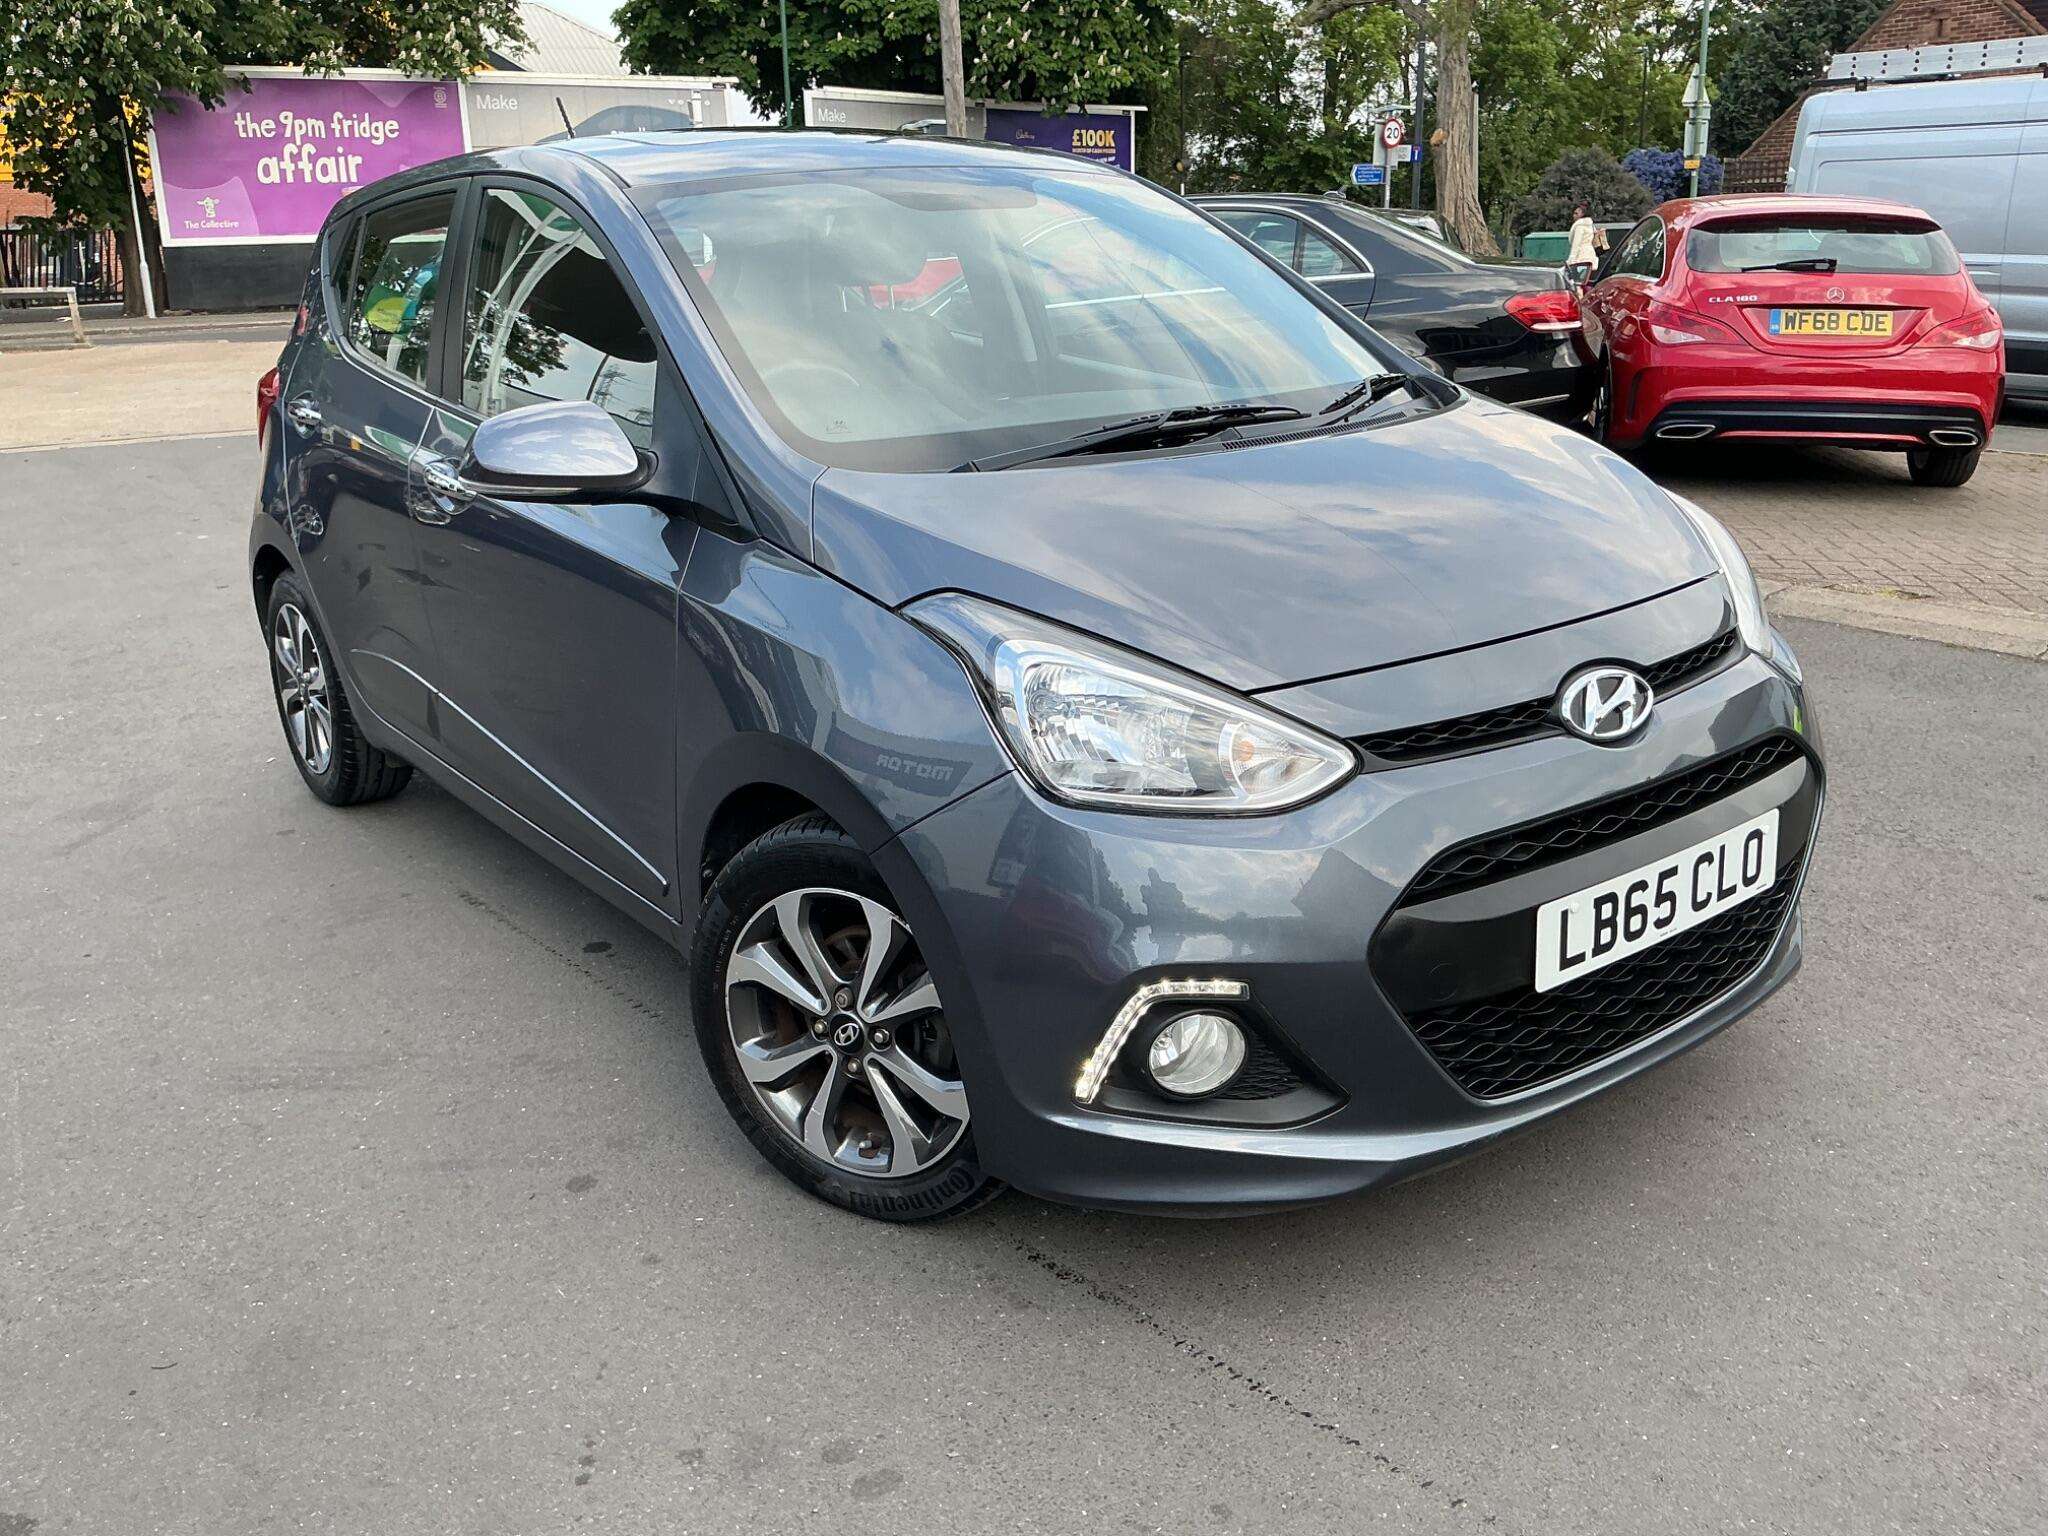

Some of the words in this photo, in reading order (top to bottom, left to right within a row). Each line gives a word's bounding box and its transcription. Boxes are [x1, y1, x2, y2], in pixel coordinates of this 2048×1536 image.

[476, 94, 518, 110] Make
[818, 108, 847, 123] Make
[234, 112, 277, 138] the
[279, 111, 326, 146] 9pm
[330, 111, 400, 145] fridge
[1386, 127, 1400, 139] 20
[1072, 129, 1117, 147] £100K
[257, 143, 363, 184] affair
[184, 220, 200, 229] The
[201, 220, 240, 229] Collective
[1784, 311, 1840, 332] WF68
[1846, 312, 1889, 332] CDE
[1558, 863, 1680, 973] LB65
[1690, 827, 1764, 914] CLO
